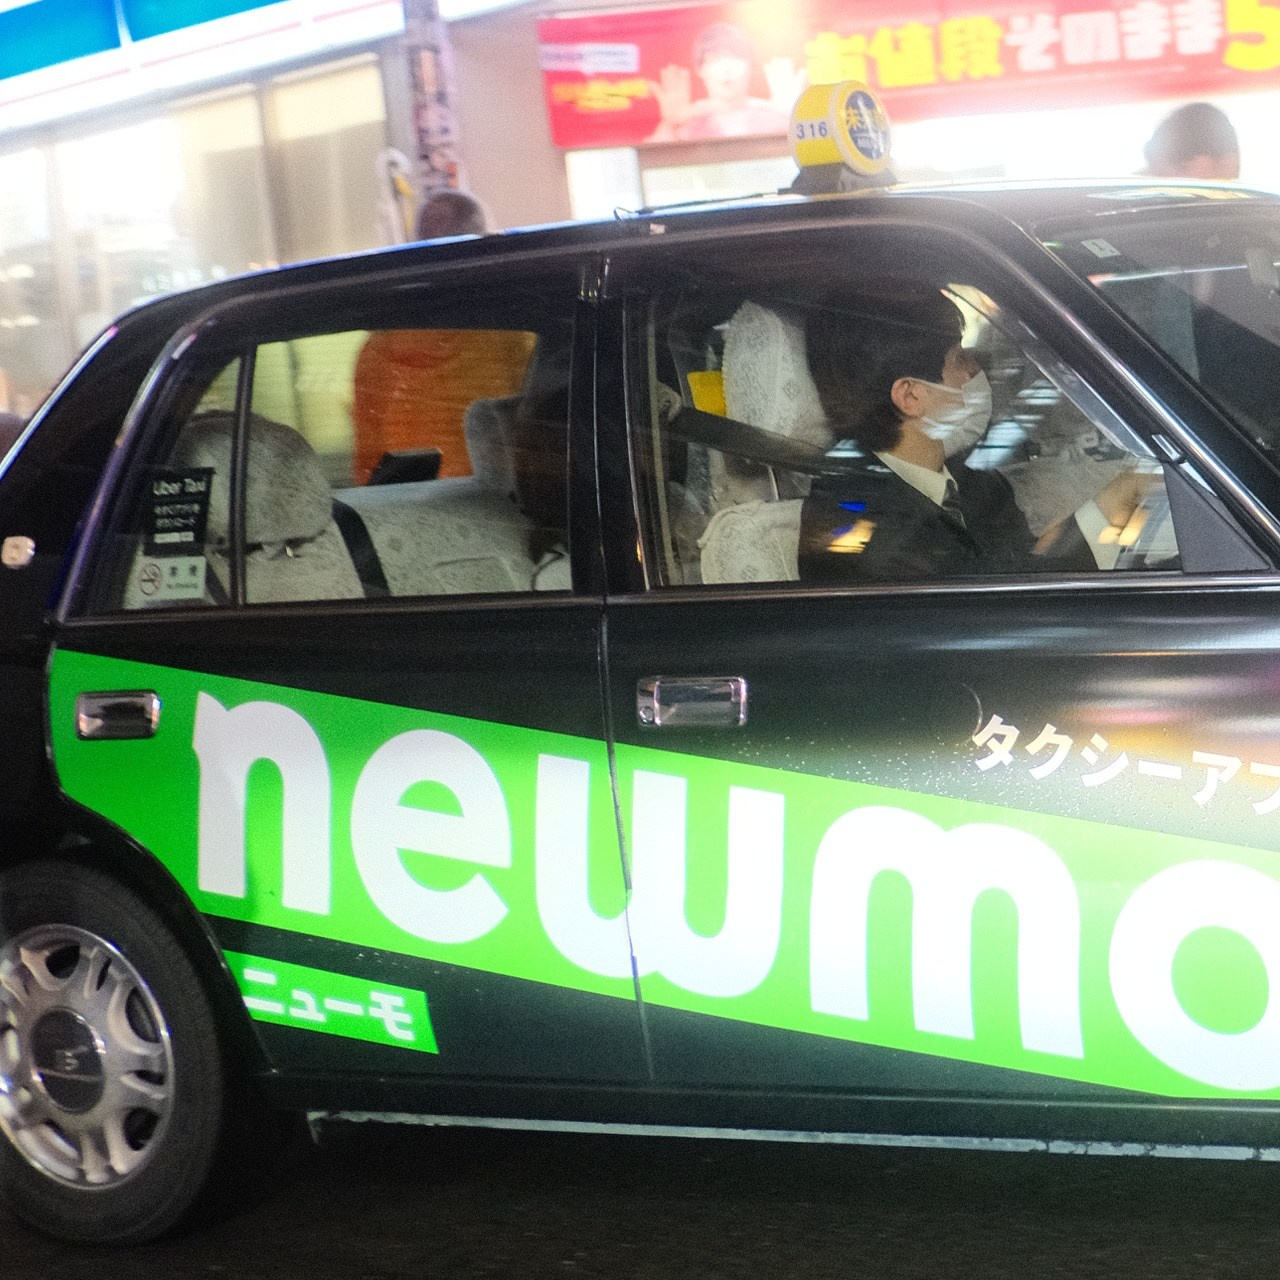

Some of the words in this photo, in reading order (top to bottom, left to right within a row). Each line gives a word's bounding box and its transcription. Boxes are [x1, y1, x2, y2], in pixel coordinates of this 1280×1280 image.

[796, 120, 828, 140] 316
[242, 967, 416, 1042] ニューモ
